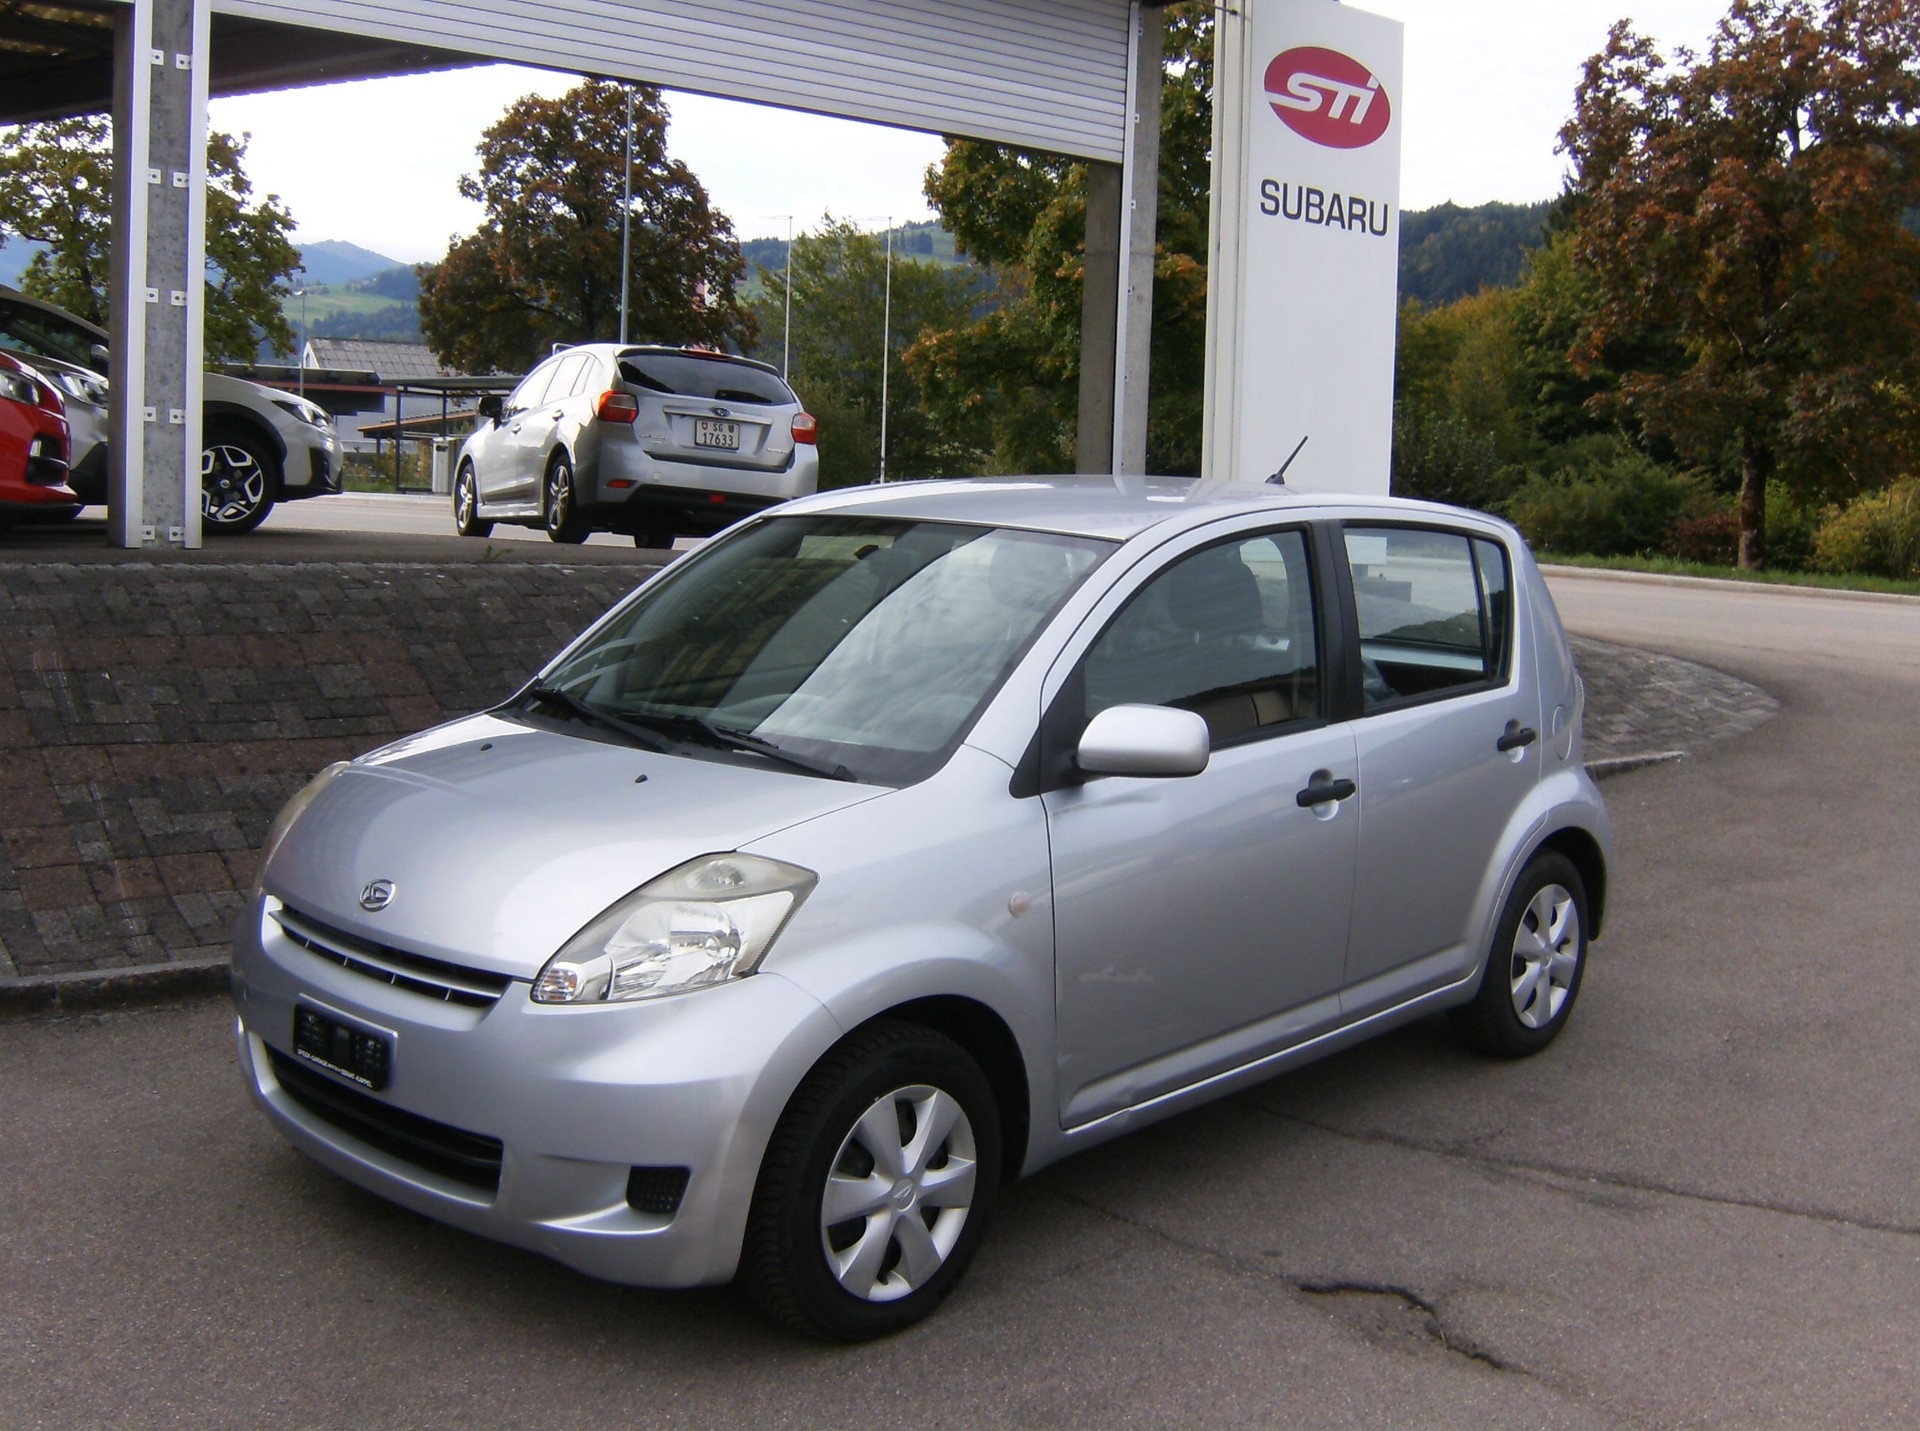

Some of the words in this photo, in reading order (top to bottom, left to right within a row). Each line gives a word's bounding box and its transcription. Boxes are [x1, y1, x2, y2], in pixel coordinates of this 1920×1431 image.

[1260, 178, 1389, 236] SUBARU
[712, 423, 724, 433] SG
[703, 432, 734, 447] 17633
